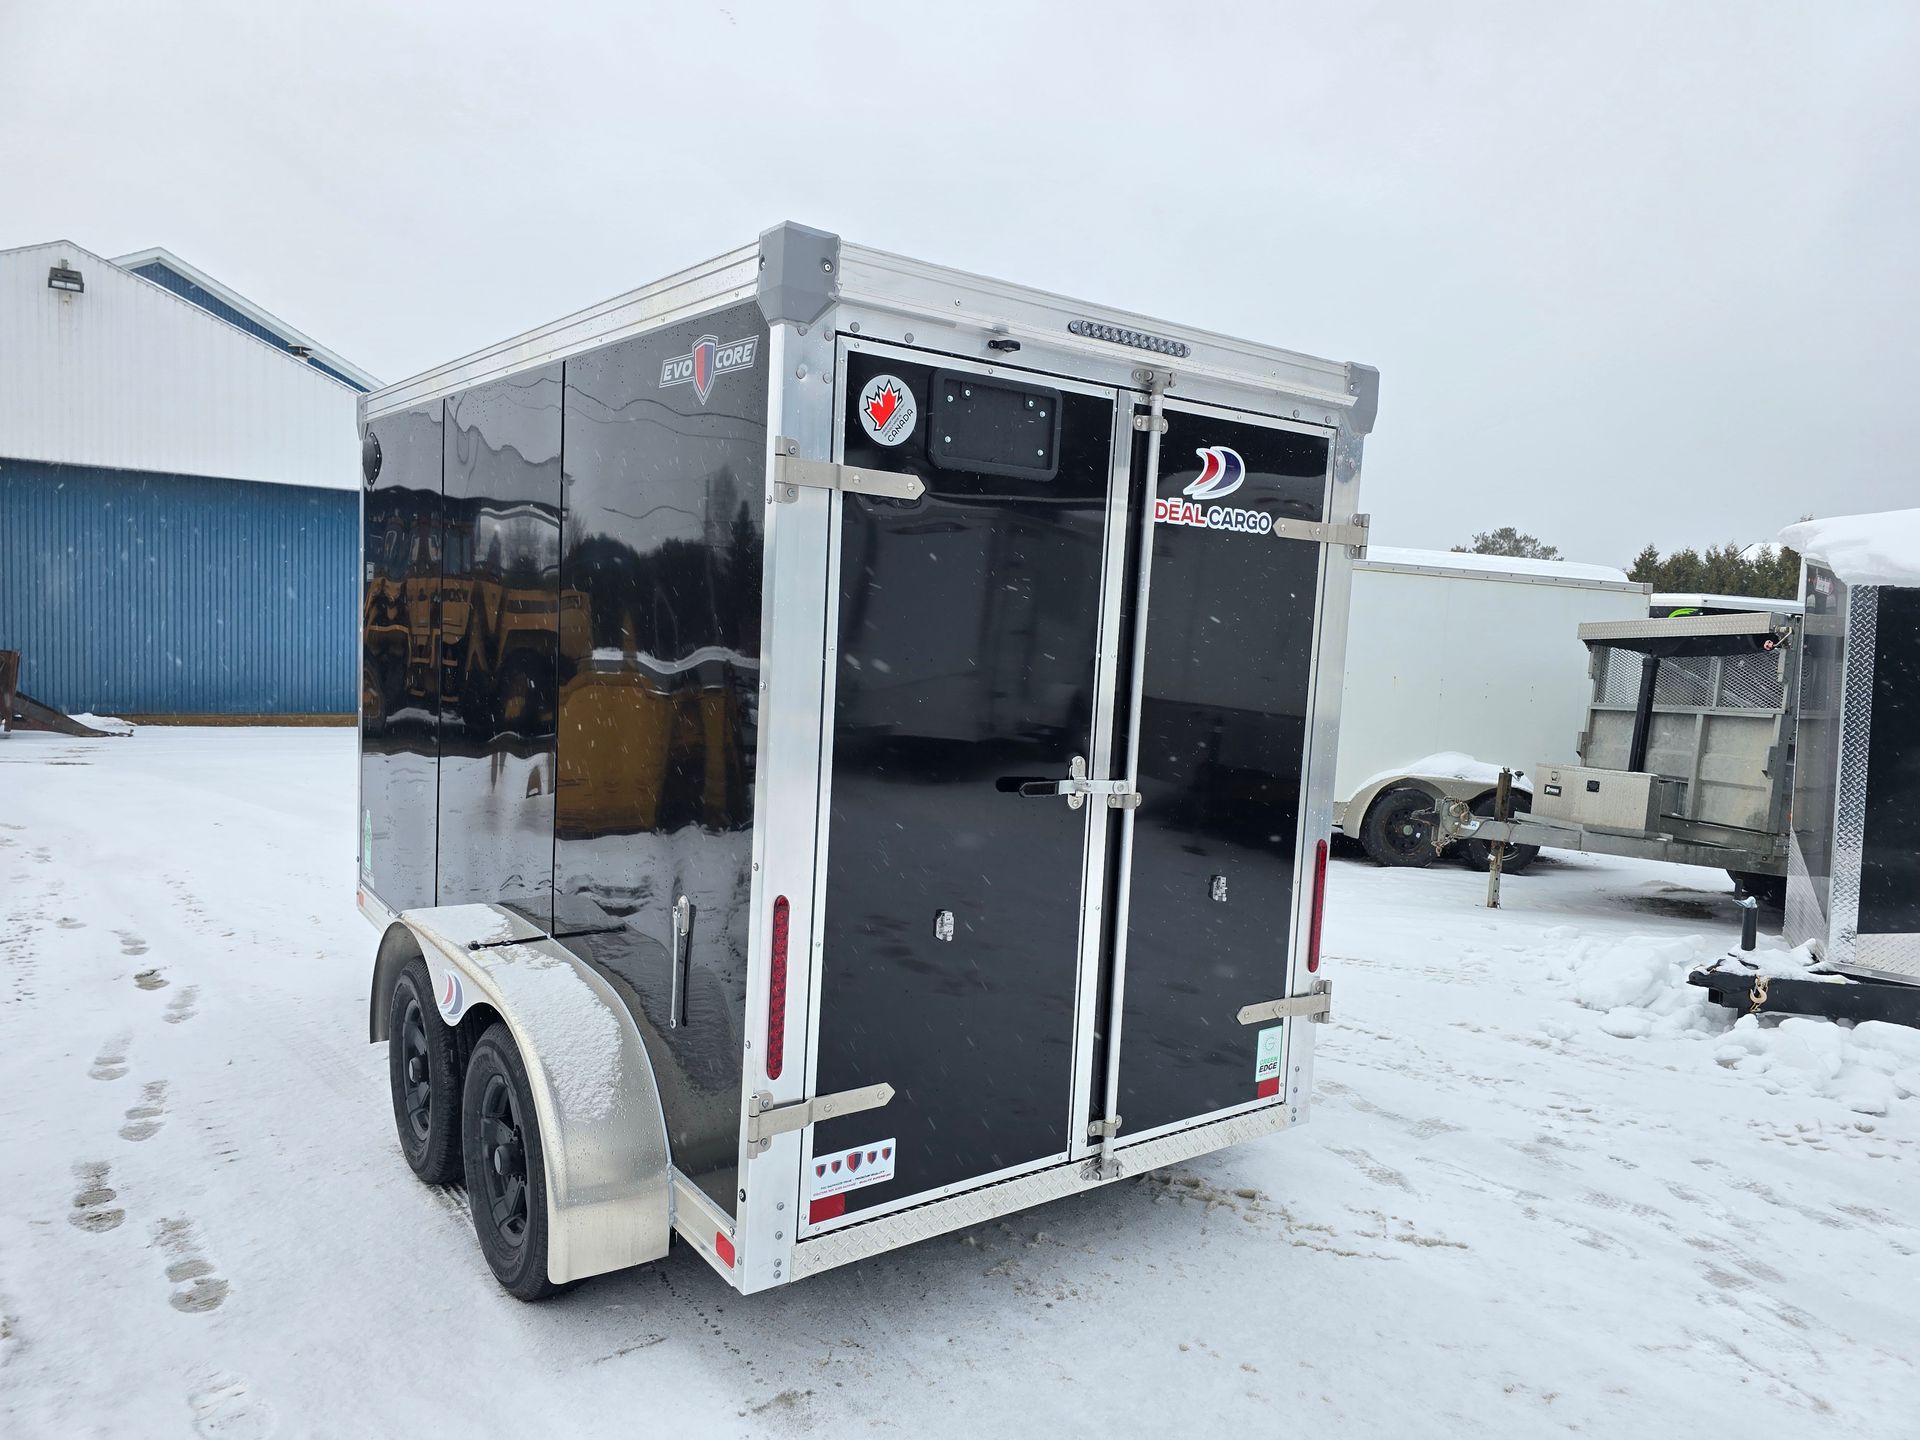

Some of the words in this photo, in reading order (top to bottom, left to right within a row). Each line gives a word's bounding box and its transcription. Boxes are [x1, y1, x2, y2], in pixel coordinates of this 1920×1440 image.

[663, 359, 693, 382] EVO
[715, 343, 754, 369] CORE
[887, 408, 914, 442] CANADA
[1208, 508, 1271, 532] CARGO
[1258, 1062, 1277, 1073] EDGE
[1260, 1056, 1278, 1066] GREEN
